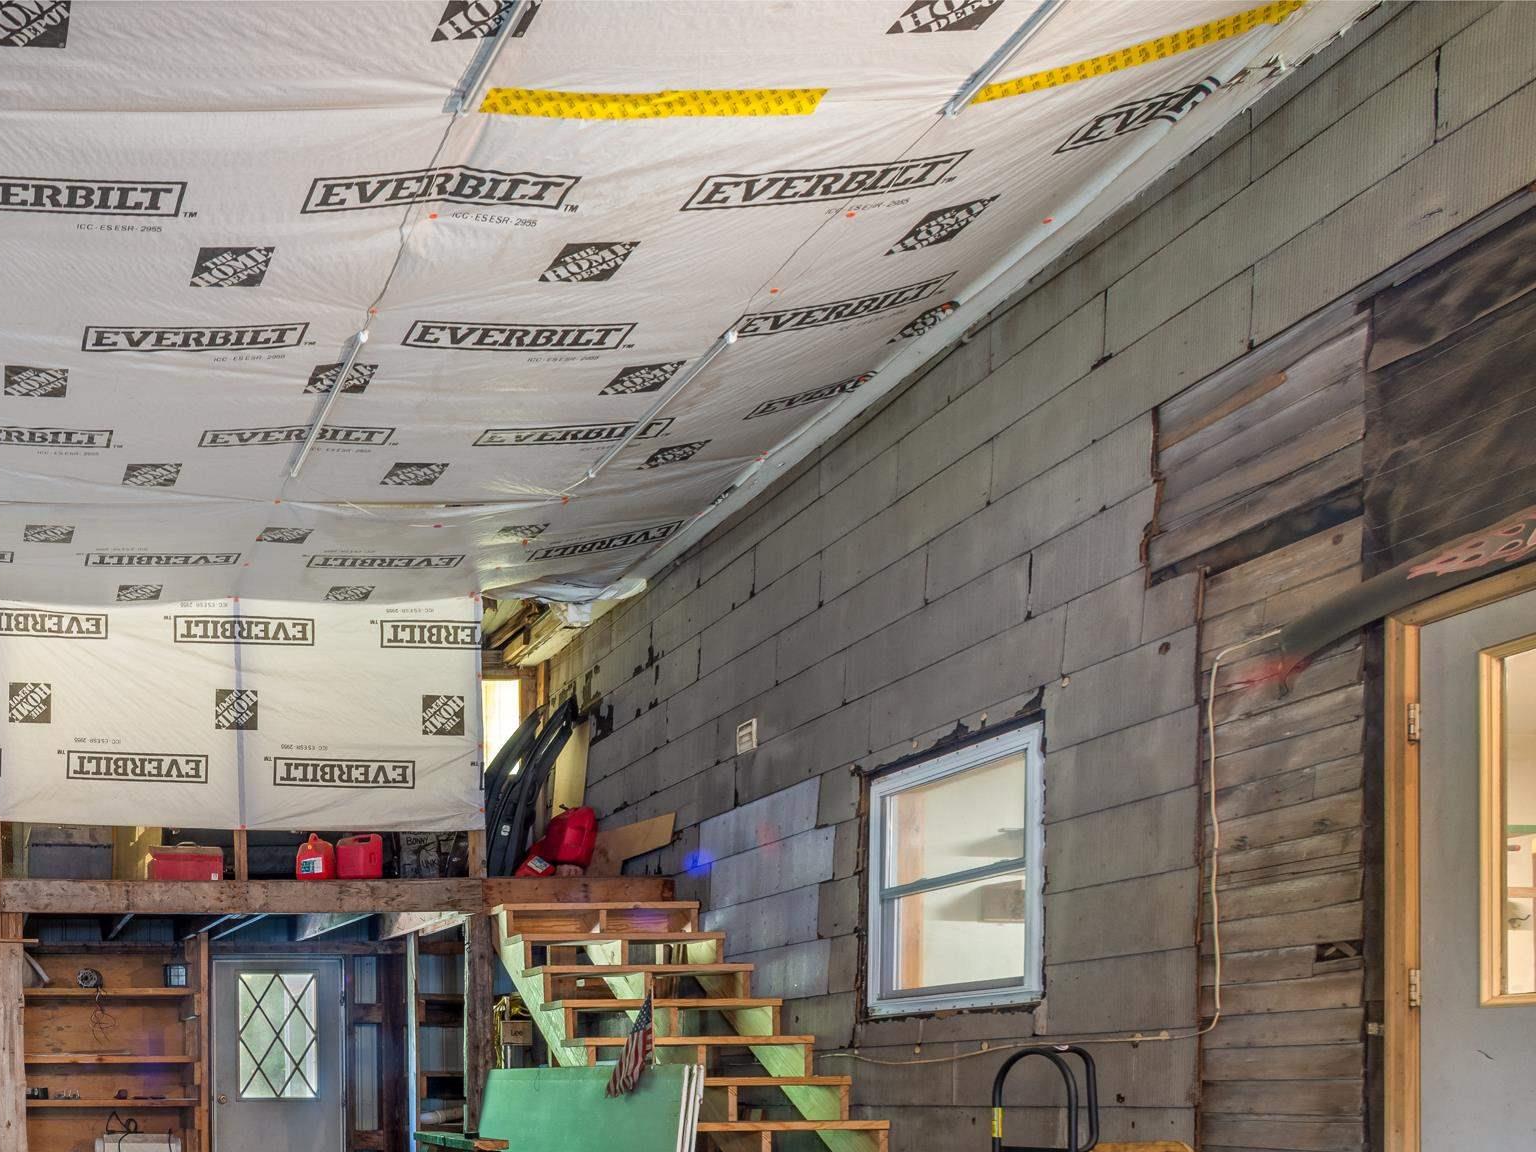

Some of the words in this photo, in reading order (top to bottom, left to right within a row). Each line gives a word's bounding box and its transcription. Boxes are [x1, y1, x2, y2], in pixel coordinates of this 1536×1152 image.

[10, 3, 70, 47] DEPOT
[315, 173, 564, 207] EVERBILT
[698, 160, 952, 205] EVERBILT
[192, 247, 272, 286] HOME
[201, 251, 236, 268] THE
[544, 242, 635, 280] HOME
[560, 246, 598, 263] THE
[219, 261, 266, 286] DEPOT
[570, 256, 623, 280] DEPOT
[737, 283, 943, 334] EVERBILT
[94, 324, 297, 347] EVERBILT
[414, 324, 623, 349] EVERBILT
[4, 368, 68, 395] HOME
[9, 370, 38, 382] THE
[30, 379, 66, 396] DEPOT
[211, 427, 385, 446] EVERBILT
[181, 619, 308, 642] EVERBILT
[9, 683, 34, 708] DEPOT
[9, 684, 51, 722] HOME
[216, 690, 241, 715] DEPOT
[29, 702, 48, 719] THE
[216, 691, 257, 729] HOME
[236, 709, 254, 726] THE
[423, 696, 447, 720] DEPOT
[423, 696, 464, 734] HOME
[442, 714, 461, 731] THE
[74, 756, 202, 778] EVERBILT
[280, 763, 410, 784] EVERBILT
